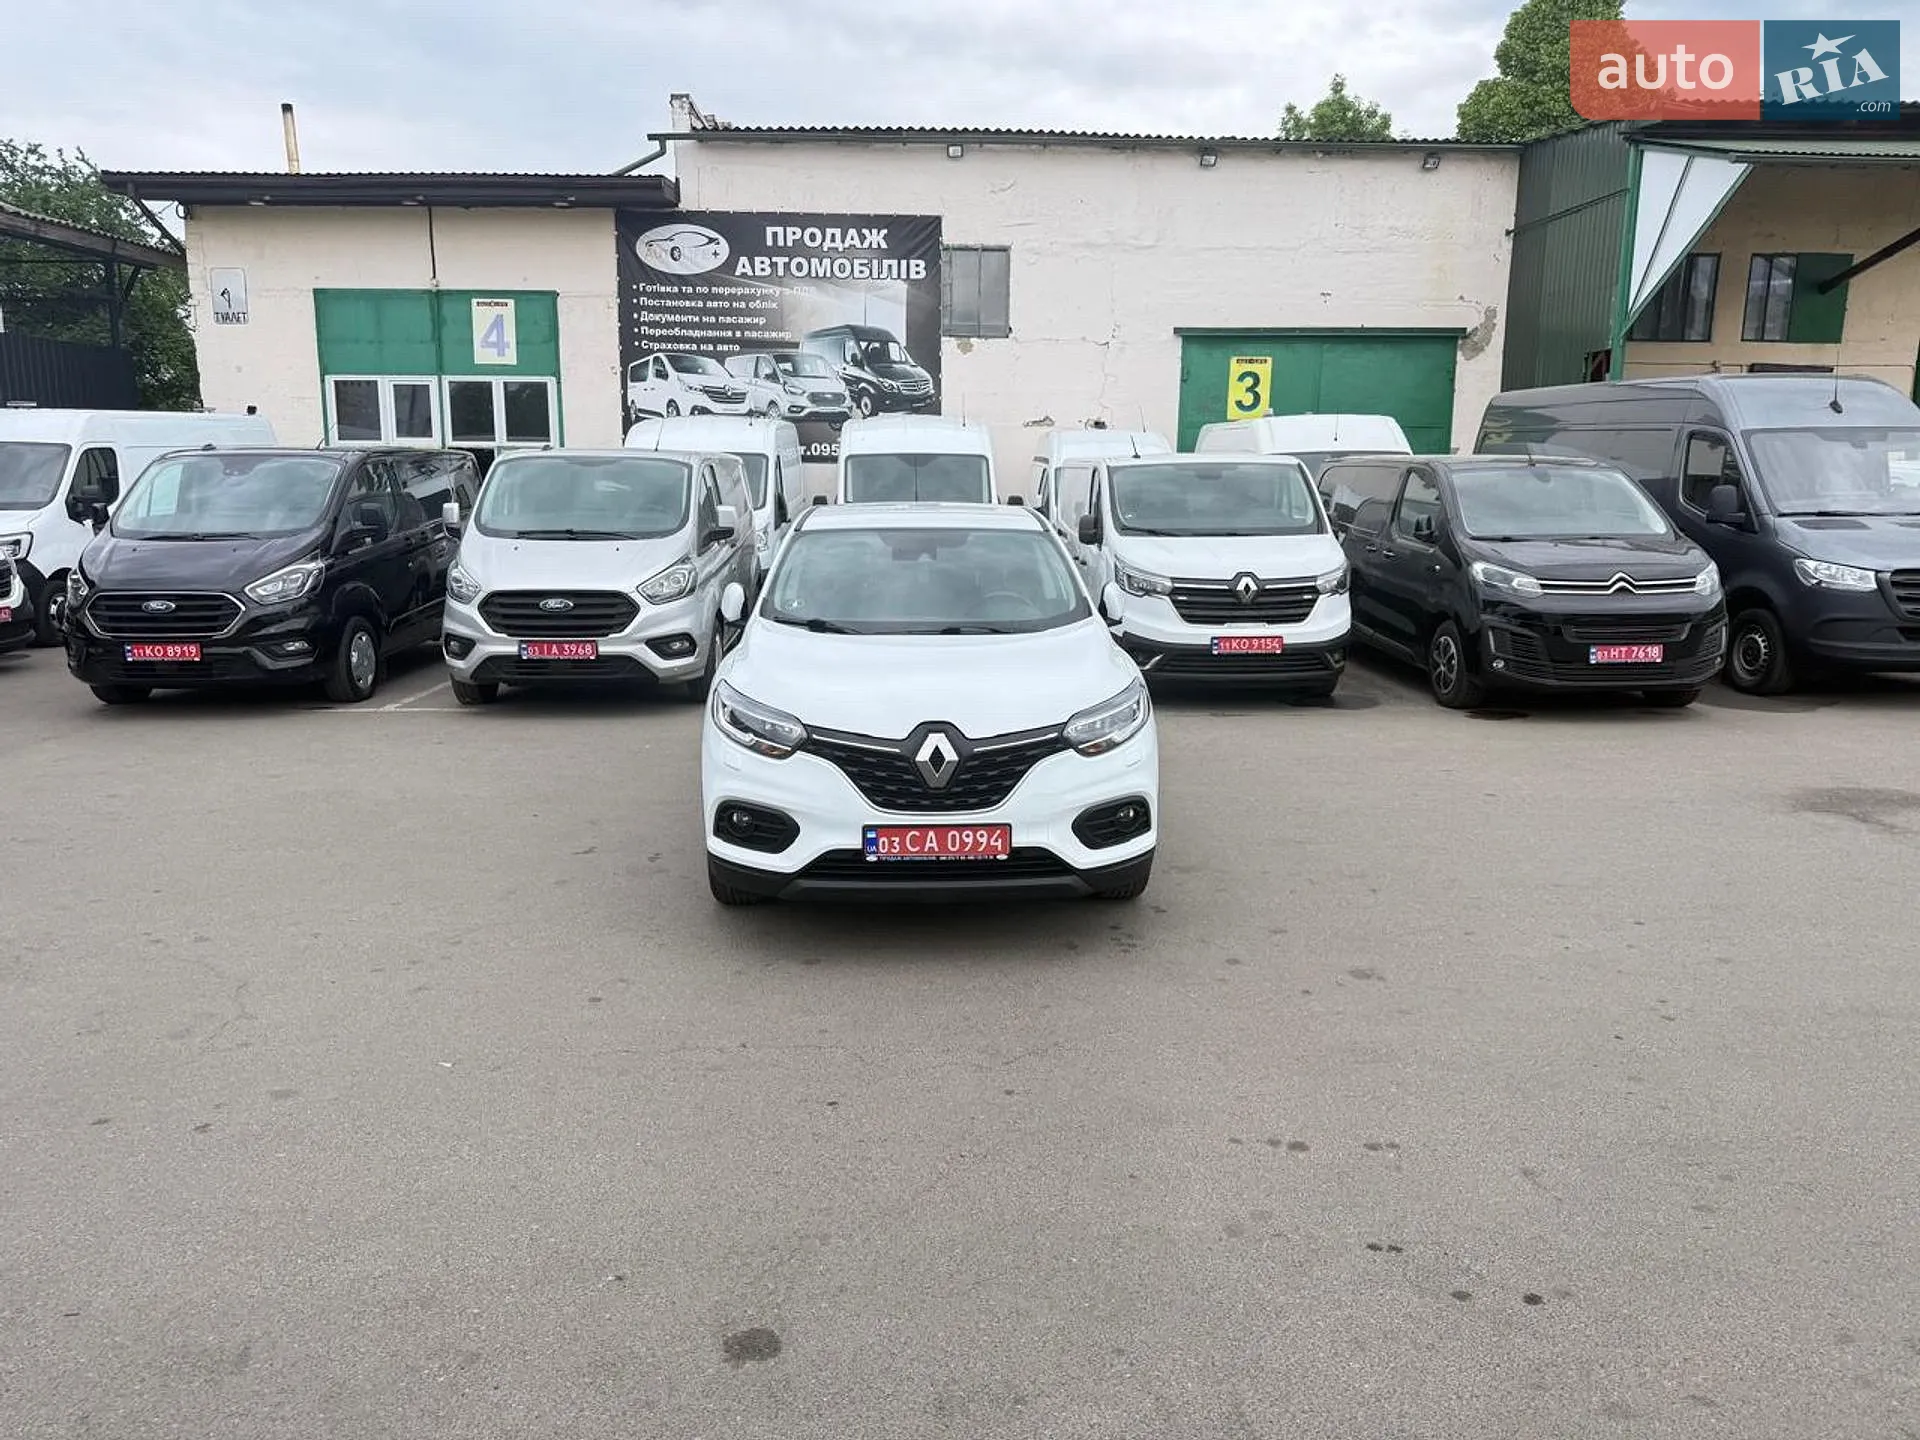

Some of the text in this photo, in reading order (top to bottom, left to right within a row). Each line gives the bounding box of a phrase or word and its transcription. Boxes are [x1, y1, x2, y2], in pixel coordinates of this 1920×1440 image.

[765, 226, 888, 251] ПРОДАЖ
[734, 256, 927, 280] АВТОМОБІЛІВ
[638, 283, 679, 294] Готівка
[682, 286, 693, 294] та
[711, 287, 780, 298] перерахунку
[639, 297, 704, 308] Постановка
[732, 301, 746, 309] на
[748, 299, 779, 310] облік
[213, 311, 248, 324] ТУАЛЕТ
[640, 311, 767, 326] Документи на пасажир
[480, 313, 511, 357] 4
[640, 326, 733, 338] Переобладнання
[744, 330, 793, 340] пасажир
[641, 340, 698, 351] Страховка
[700, 343, 714, 351] на
[1235, 370, 1261, 412] 3
[947, 829, 1003, 852] 0994
